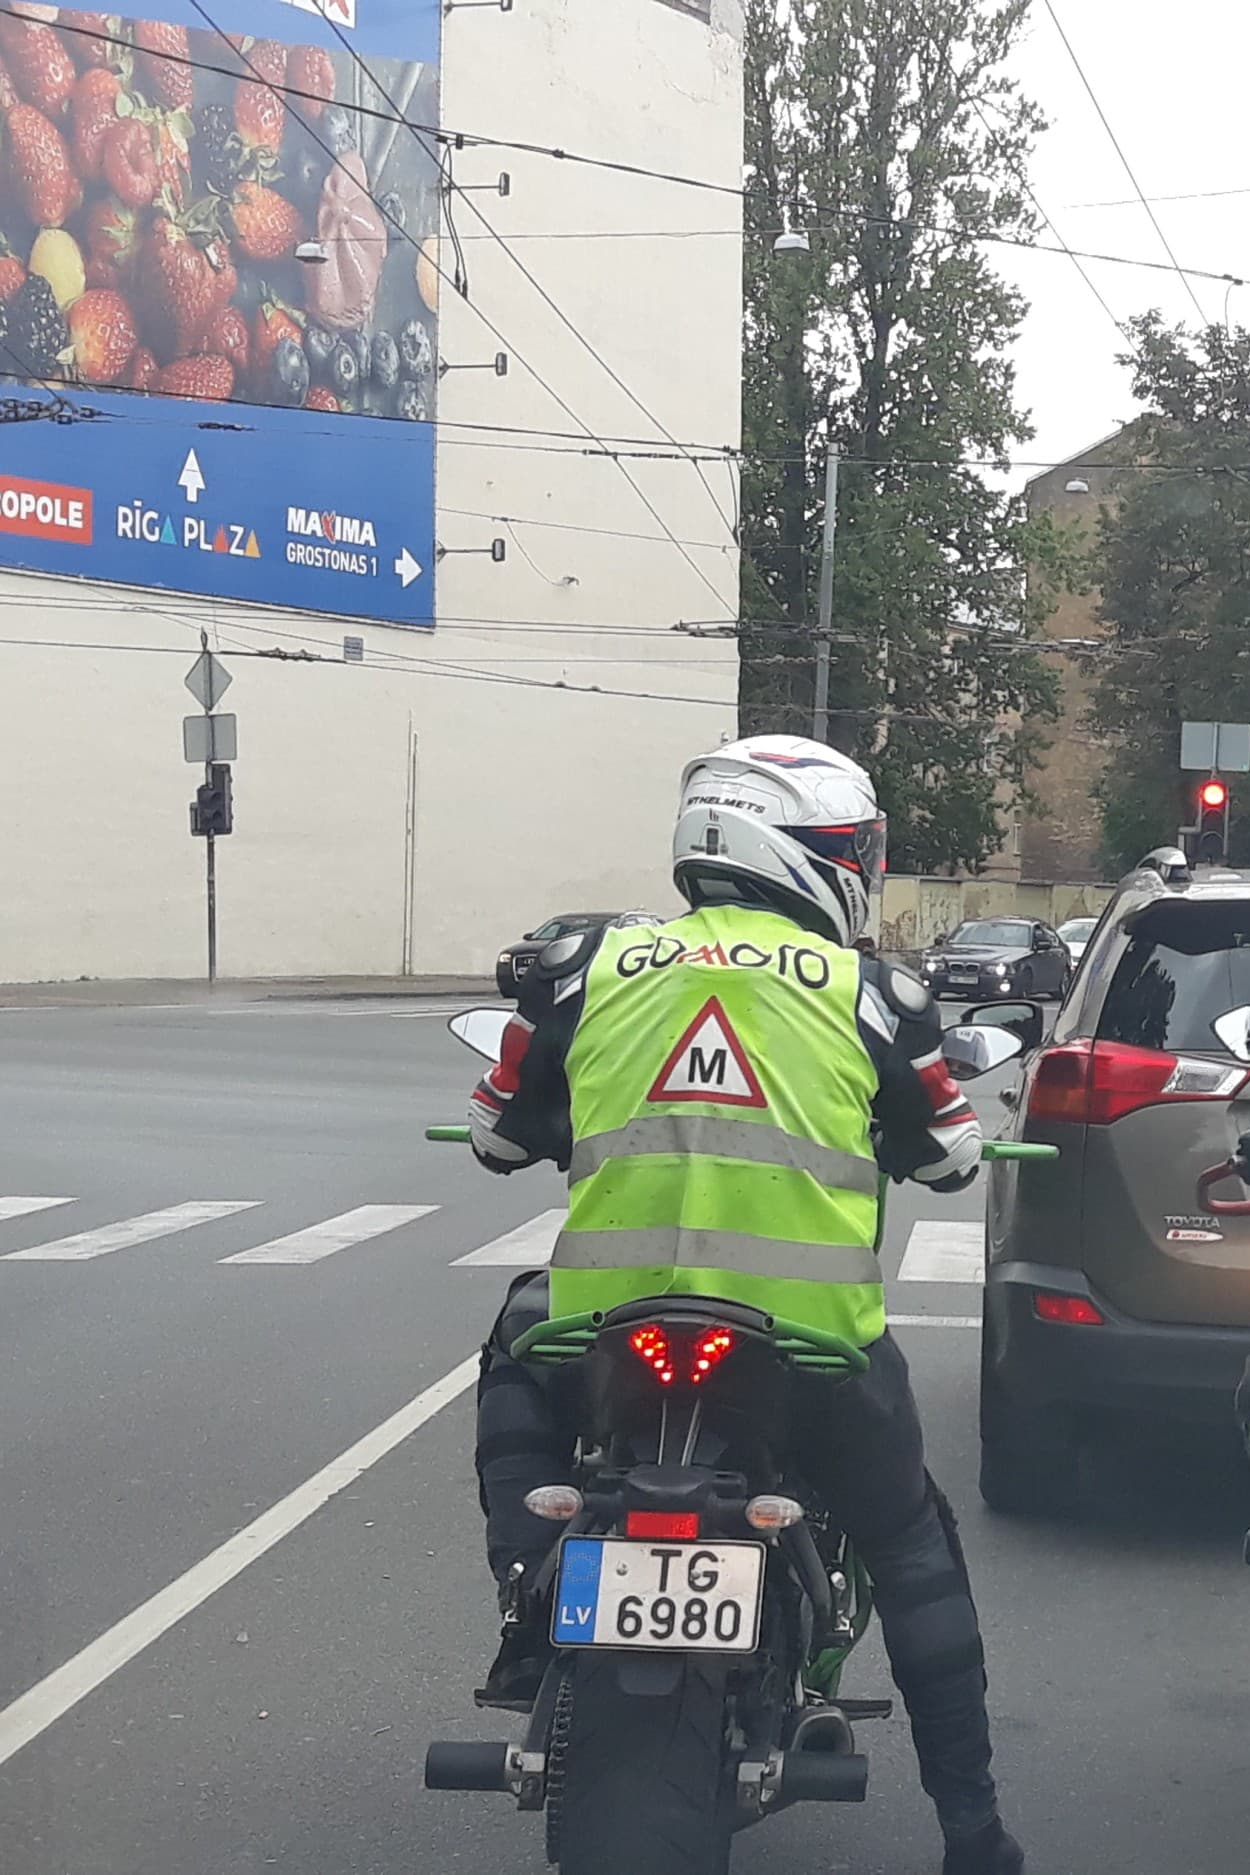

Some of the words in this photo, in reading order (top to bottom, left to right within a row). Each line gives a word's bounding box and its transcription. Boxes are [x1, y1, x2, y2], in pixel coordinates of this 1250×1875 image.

[0, 490, 84, 529] OPOLE
[287, 506, 377, 548] MAXIMA
[286, 542, 368, 576] GROSTONAS
[370, 556, 378, 577] 1
[687, 1047, 728, 1085] M
[1164, 1215, 1221, 1228] TOYOTA
[650, 1549, 719, 1593] TG
[561, 1606, 592, 1625] LV
[616, 1595, 742, 1642] 6980
